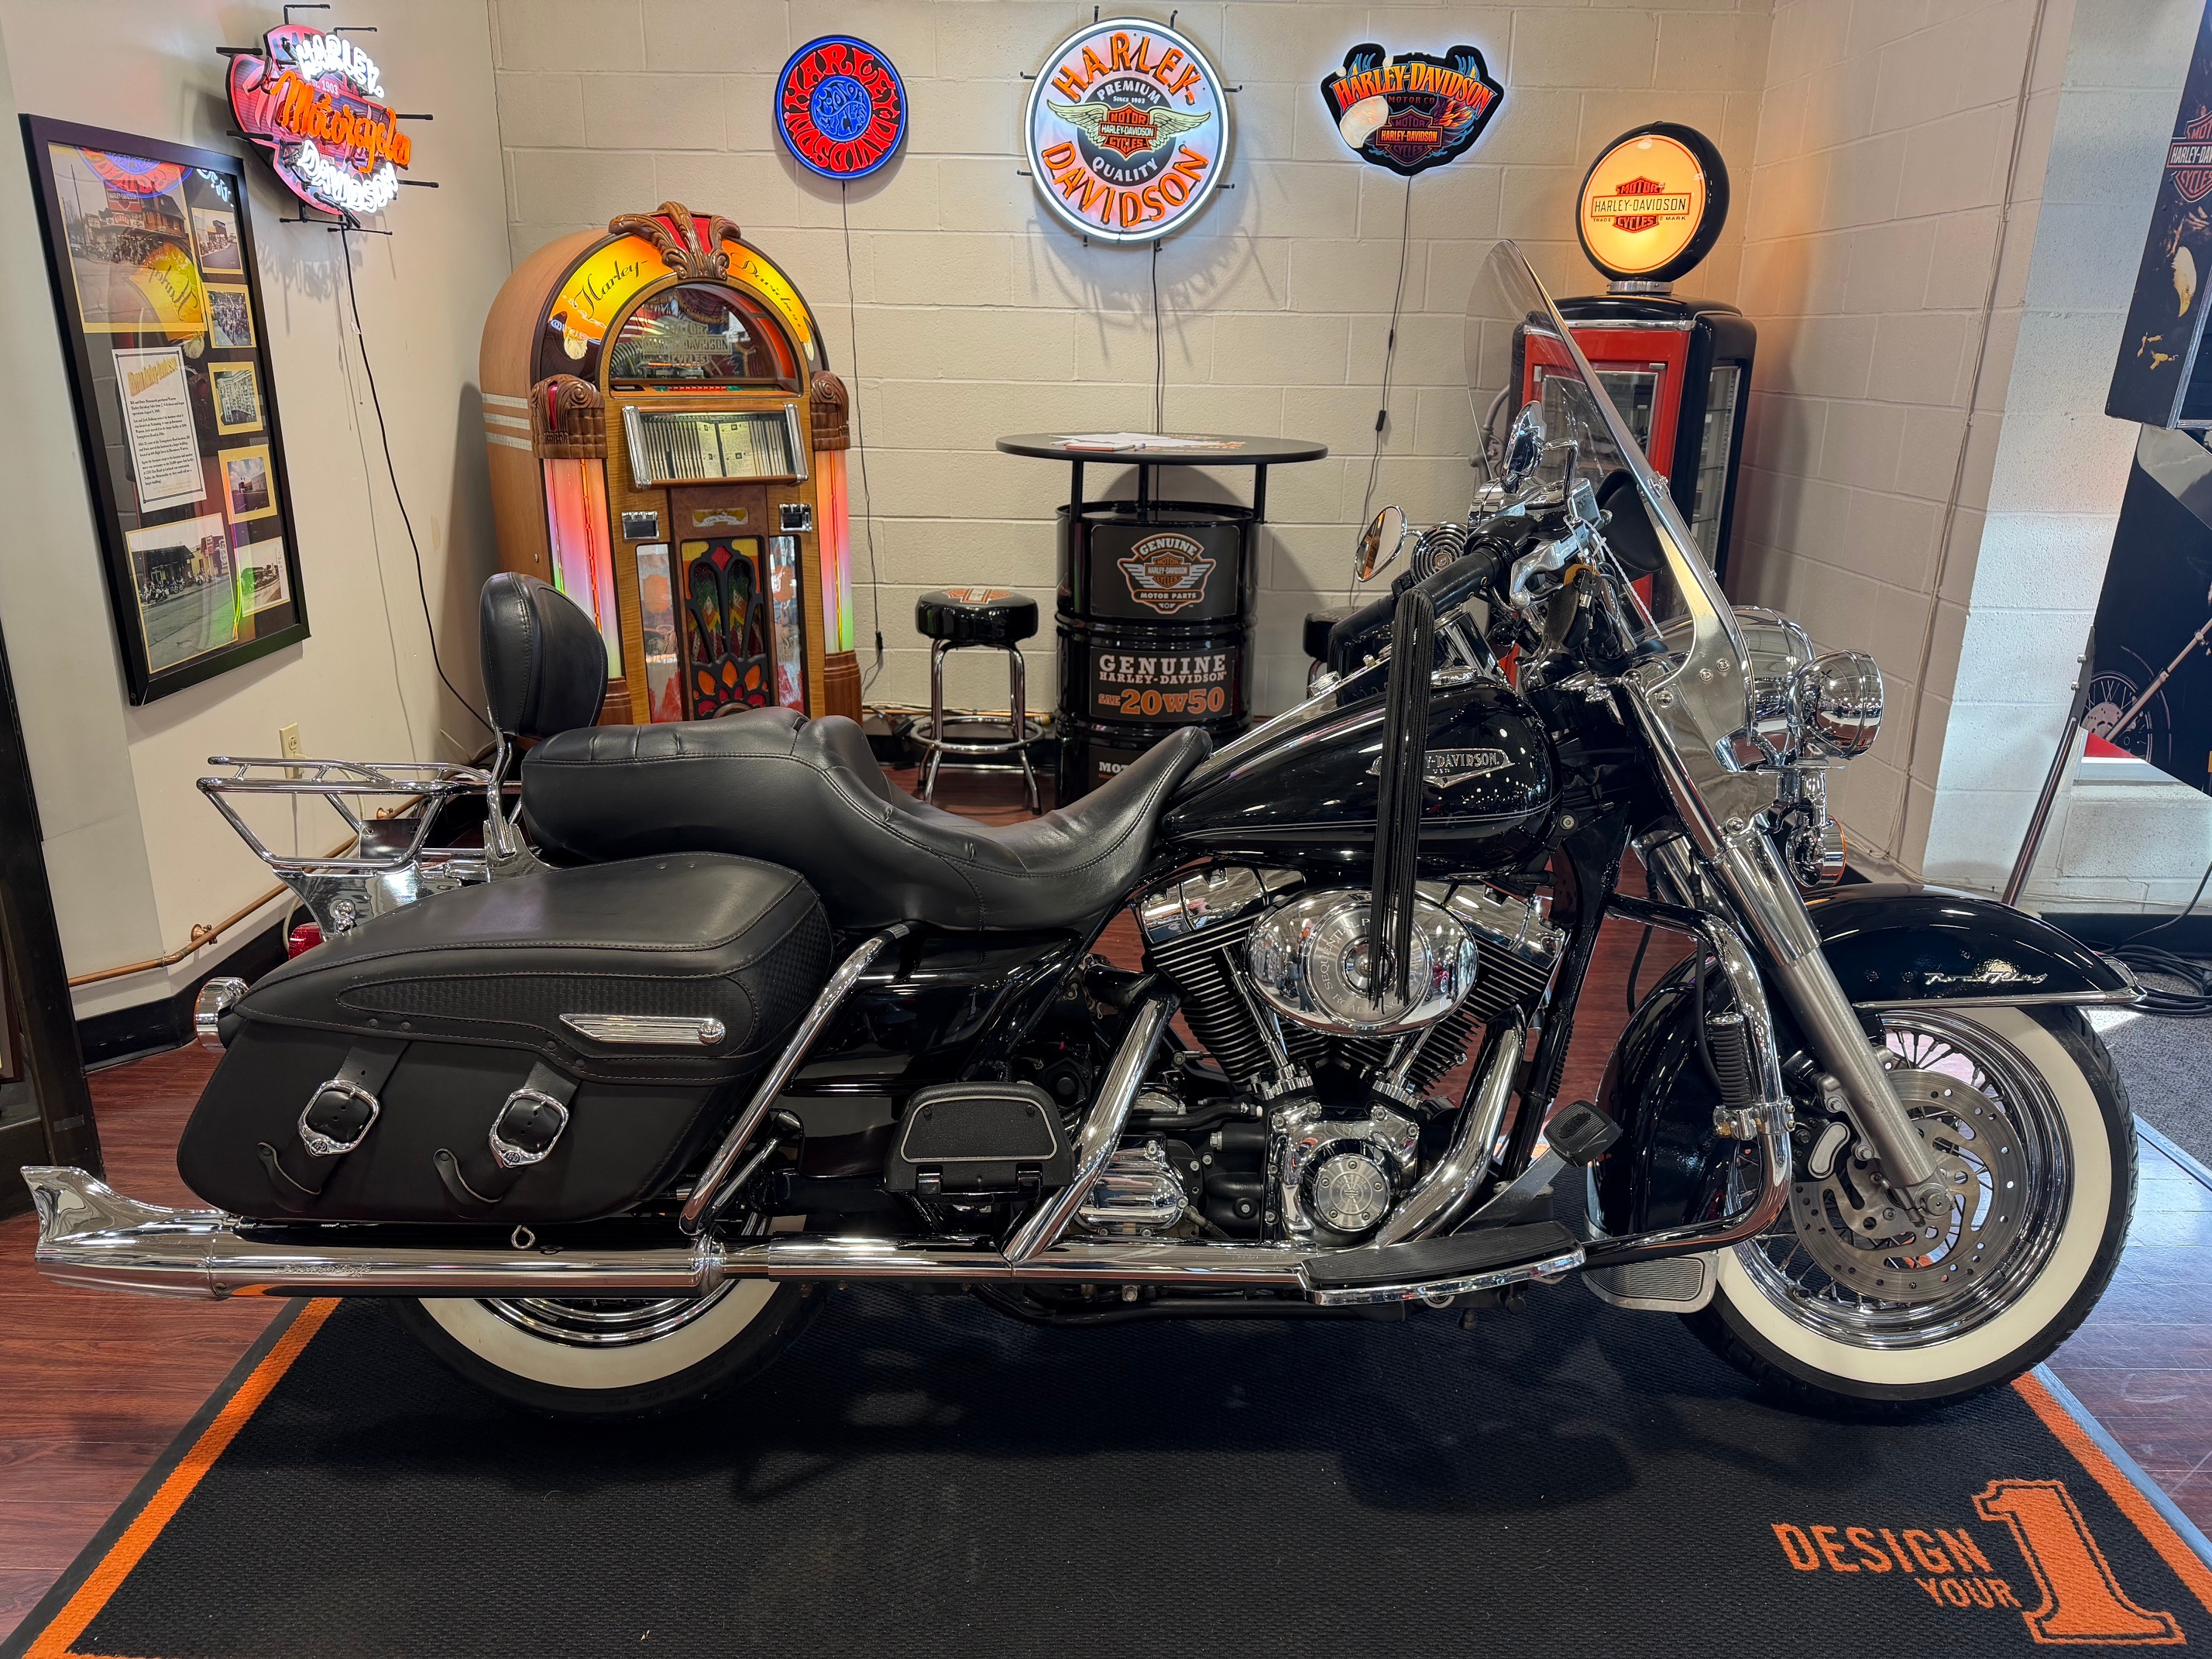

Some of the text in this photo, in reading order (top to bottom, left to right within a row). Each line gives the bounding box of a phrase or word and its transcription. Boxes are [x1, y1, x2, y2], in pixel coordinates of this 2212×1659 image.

[321, 80, 338, 95] 1903
[1097, 80, 1161, 104] PREMIUM
[1332, 62, 1496, 117] HARLEY-DAVIDSON
[270, 70, 410, 173] Motorcycles
[1110, 109, 1147, 124] MOTOR
[1396, 118, 1425, 127] MOTOR
[1101, 124, 1154, 136] HARLEY-DAVIDSON
[1381, 130, 1437, 143] HARLEY-DAVIDSON
[1109, 137, 1144, 152] CYCLES
[1393, 144, 1423, 157] CYCLES
[297, 139, 398, 213] DAVIDSON
[1092, 156, 1158, 182] QUALITY
[1042, 141, 1209, 228] DAVIDSON
[1621, 180, 1658, 194] MOTOR
[1594, 198, 1686, 212] HARLEY-DAVIDSON
[1617, 217, 1654, 231] CYCLES
[1139, 538, 1197, 556] GENUINE
[1156, 576, 1179, 586] CYCLES
[1099, 654, 1226, 675] GENUINE
[1099, 671, 1227, 685] HARLEY-DAVIDSON
[1098, 693, 1121, 706] SAE
[1321, 920, 1359, 991] SEQUENTIAL
[1772, 1523, 1993, 1574] DESIGN
[1915, 1479, 2187, 1645] YOUR 1
